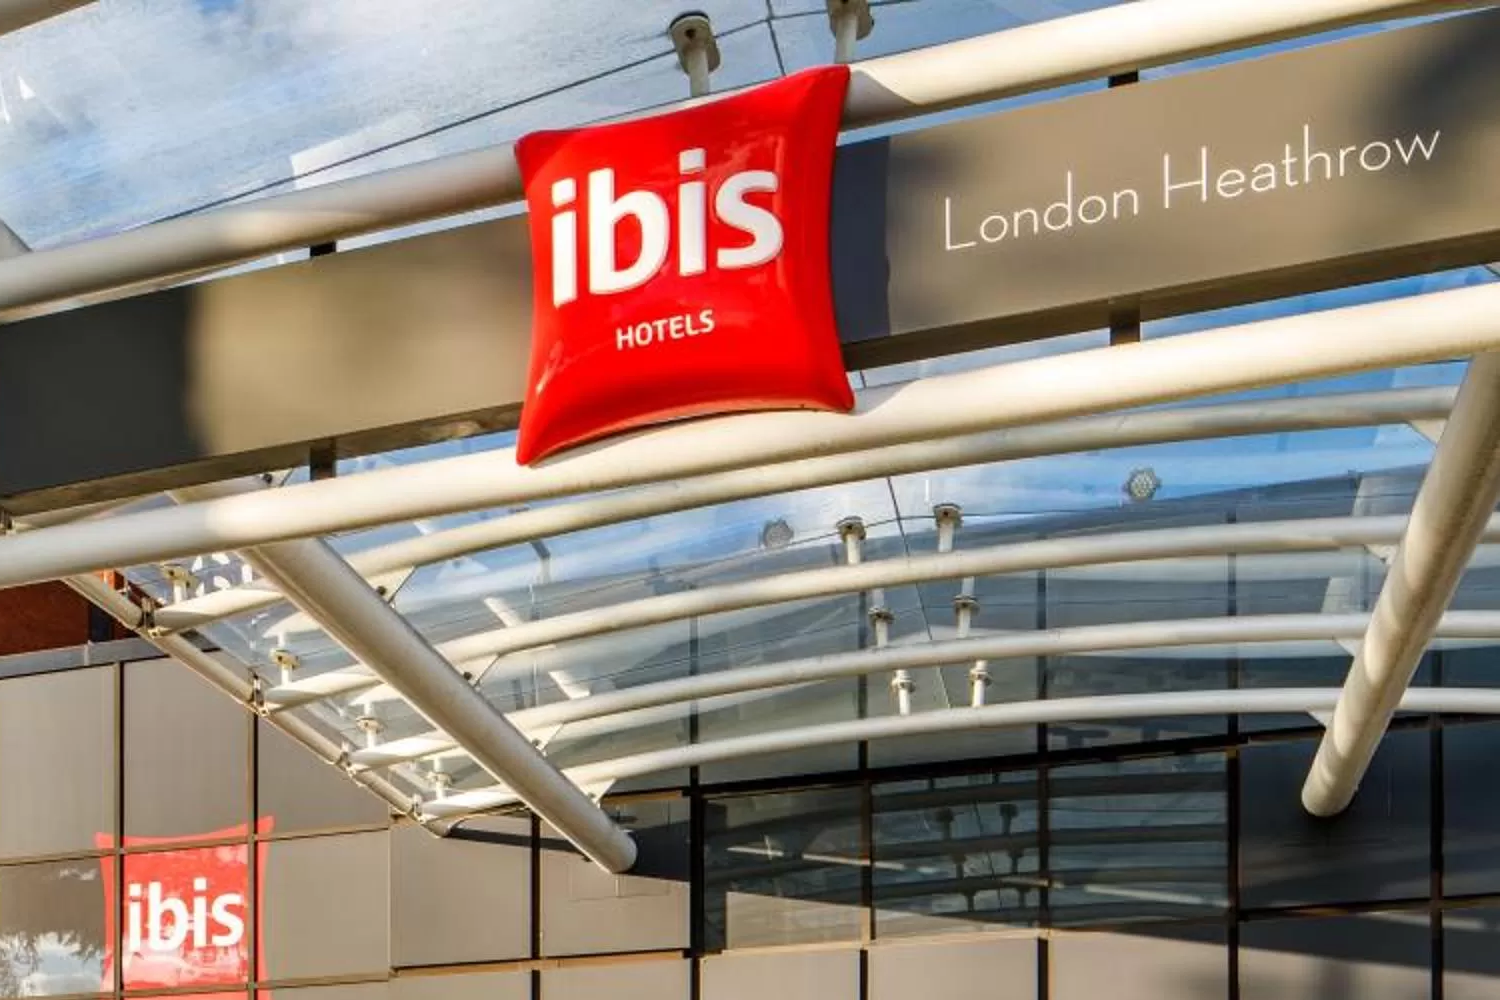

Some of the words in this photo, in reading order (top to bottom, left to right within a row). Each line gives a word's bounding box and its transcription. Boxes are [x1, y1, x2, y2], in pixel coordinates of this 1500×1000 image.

[551, 148, 784, 307] ibis
[944, 171, 1140, 251] London
[1163, 124, 1441, 209] Heathrow
[615, 309, 716, 349] HOTELS
[128, 877, 244, 953] ibis
